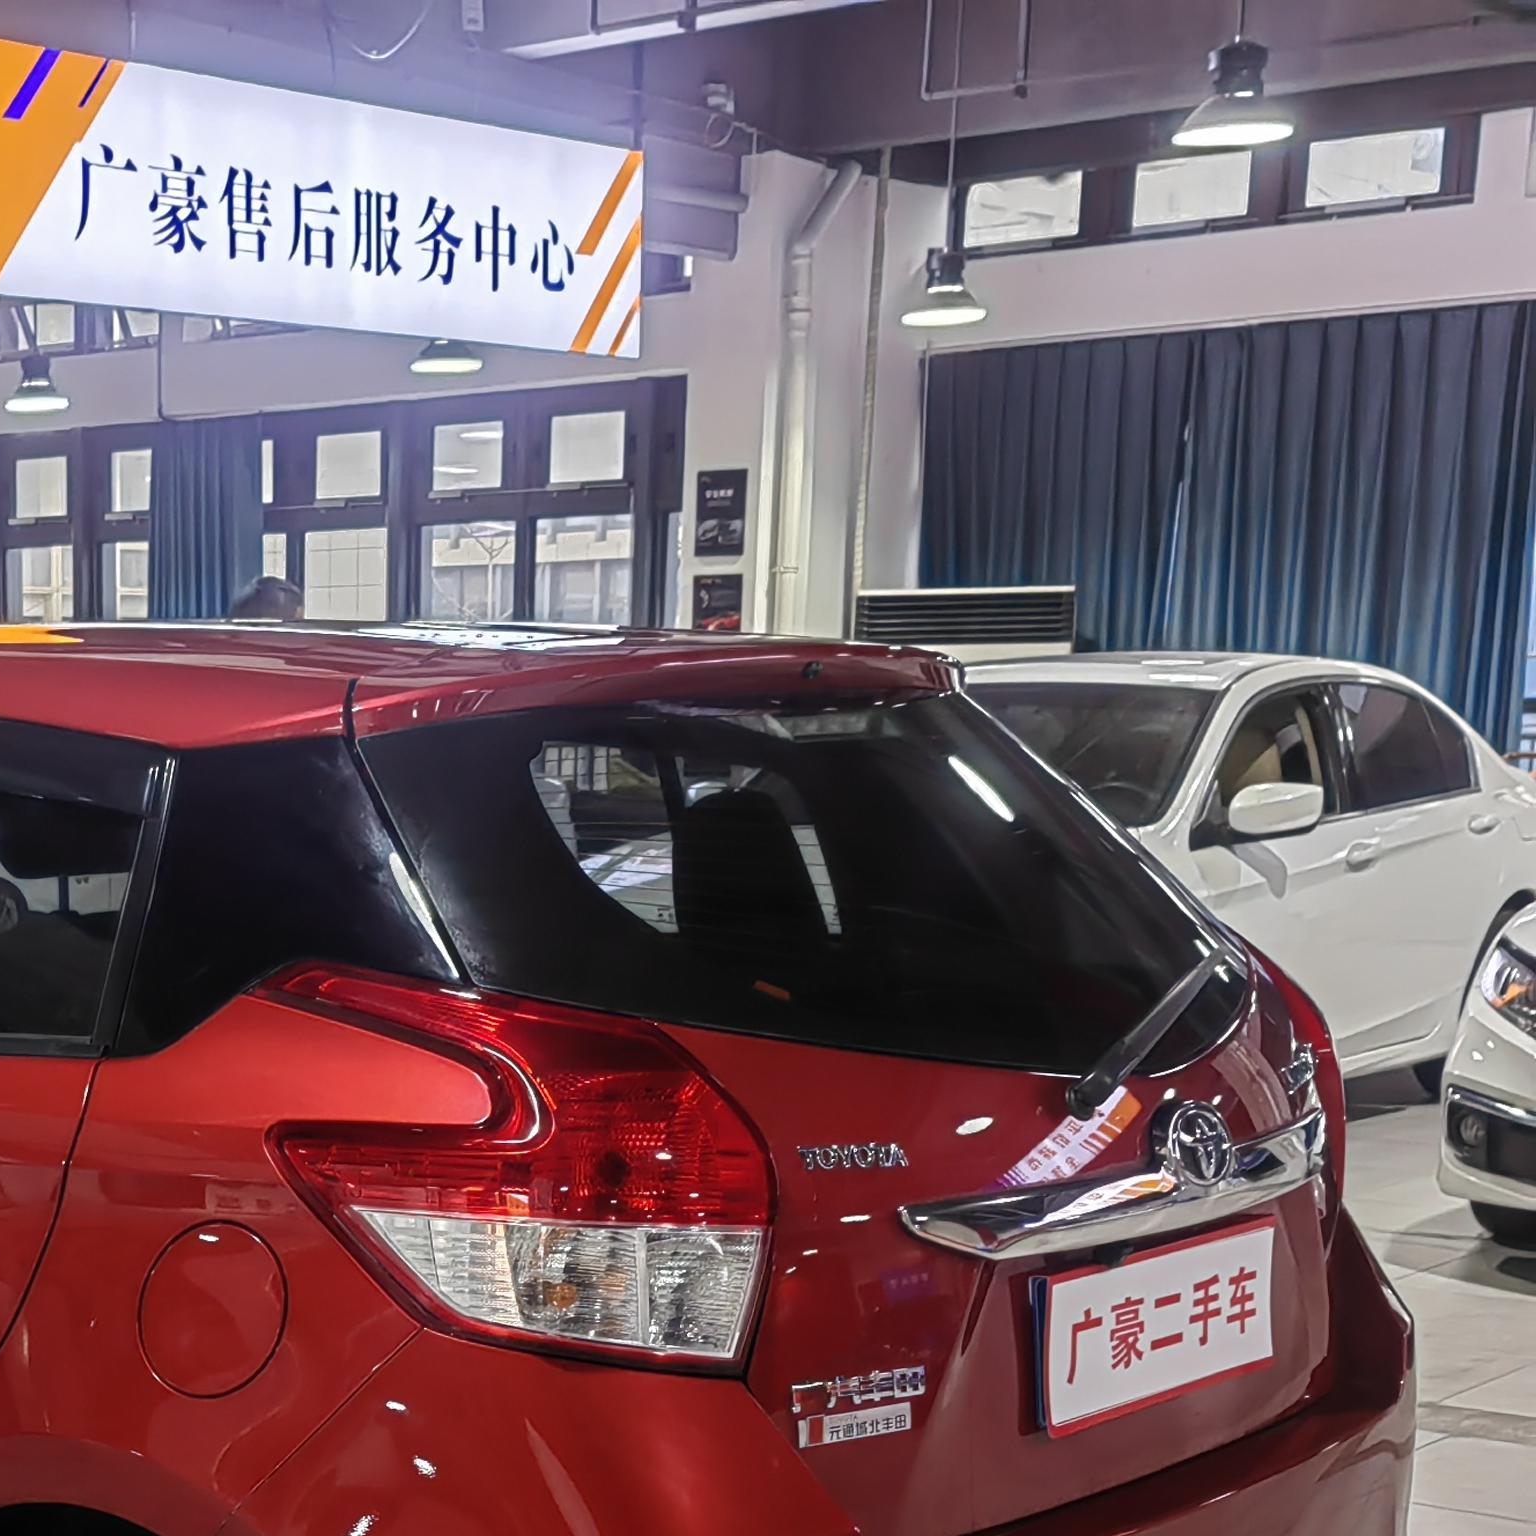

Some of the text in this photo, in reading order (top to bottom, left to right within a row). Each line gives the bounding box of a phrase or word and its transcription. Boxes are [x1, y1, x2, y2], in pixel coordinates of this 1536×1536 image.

[73, 144, 577, 294] 广豪售后服务中心
[797, 1142, 909, 1170] TOYOTA
[1066, 1266, 1258, 1386] 广豪二手车
